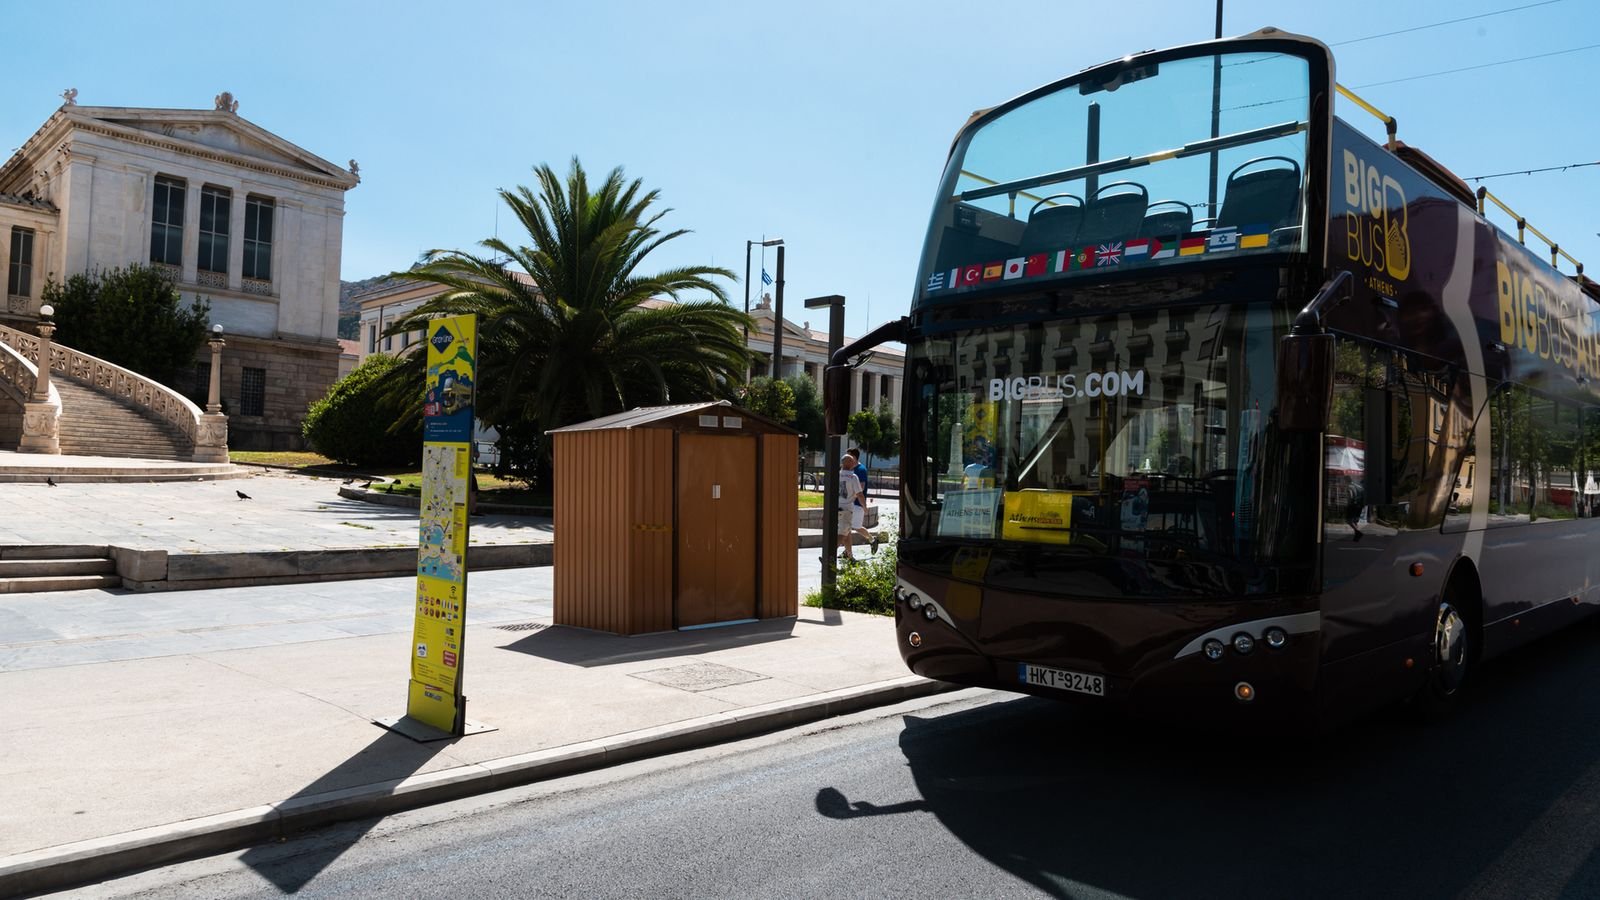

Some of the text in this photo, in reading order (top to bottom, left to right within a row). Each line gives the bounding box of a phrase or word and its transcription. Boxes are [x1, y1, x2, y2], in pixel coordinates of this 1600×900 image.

[1343, 148, 1382, 219] BIG
[1346, 209, 1385, 273] BUS
[1369, 277, 1394, 297] ATHENS
[989, 369, 1145, 401] BIGBUS.COM
